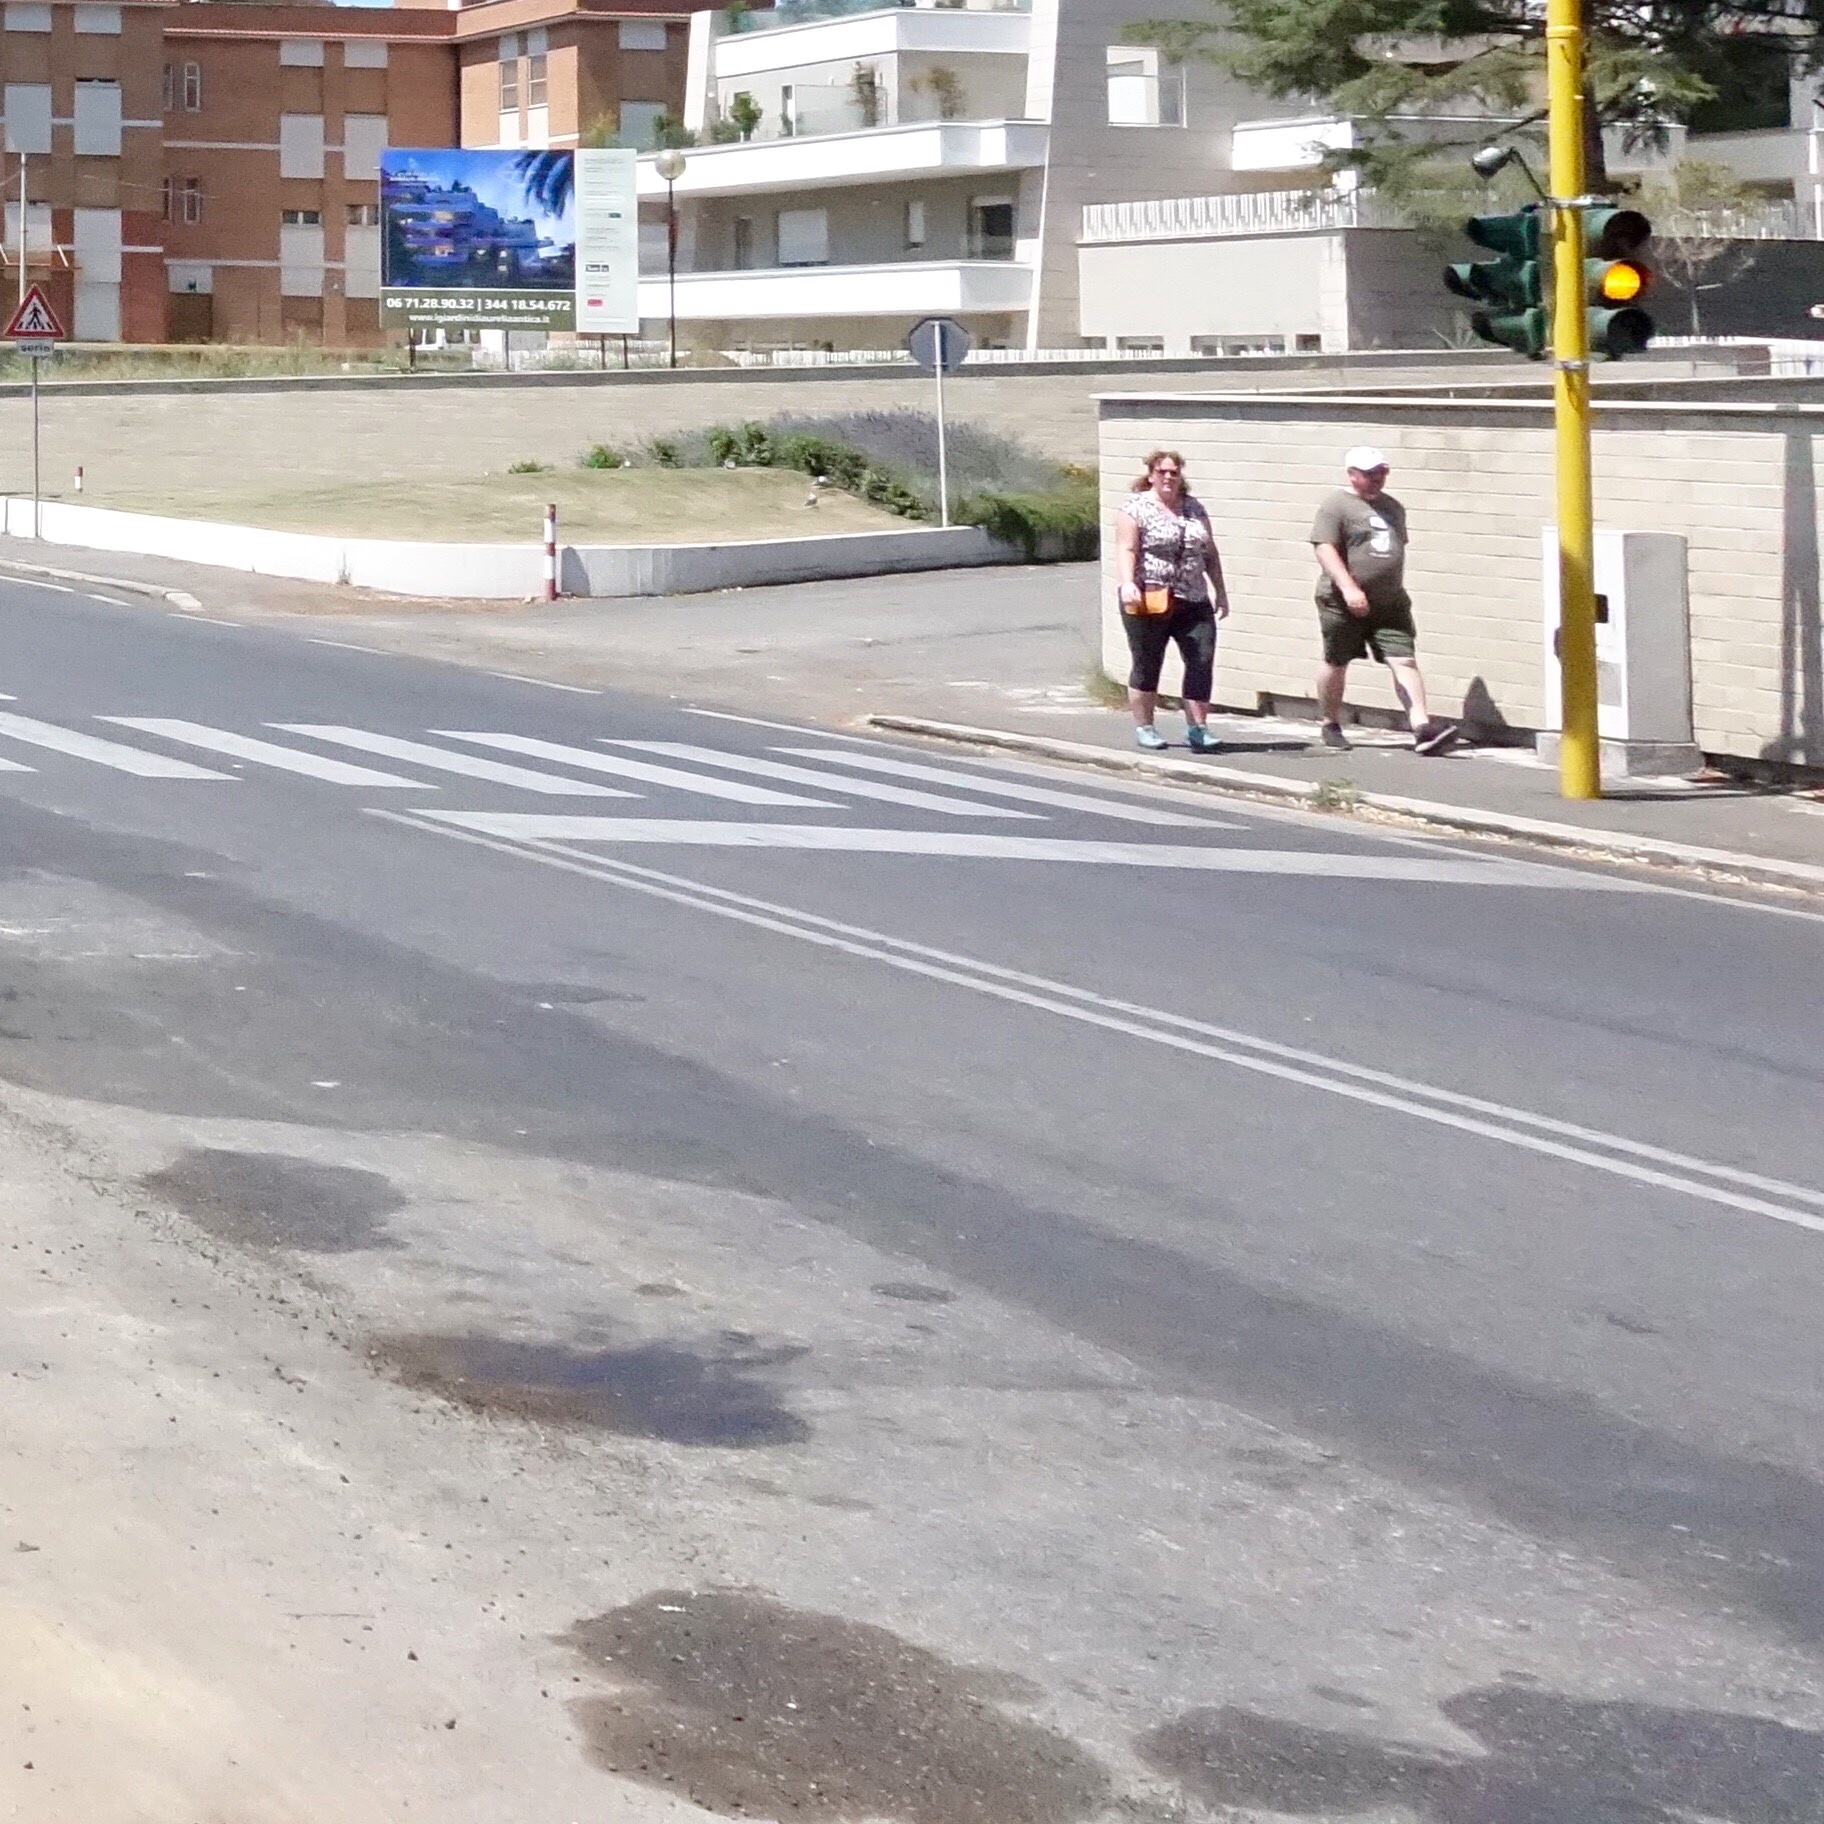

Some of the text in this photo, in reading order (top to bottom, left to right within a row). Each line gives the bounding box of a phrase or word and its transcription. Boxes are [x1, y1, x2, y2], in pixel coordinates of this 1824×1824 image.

[386, 297, 402, 308] 06
[484, 298, 508, 310] 344
[511, 299, 572, 311] 18.54.672
